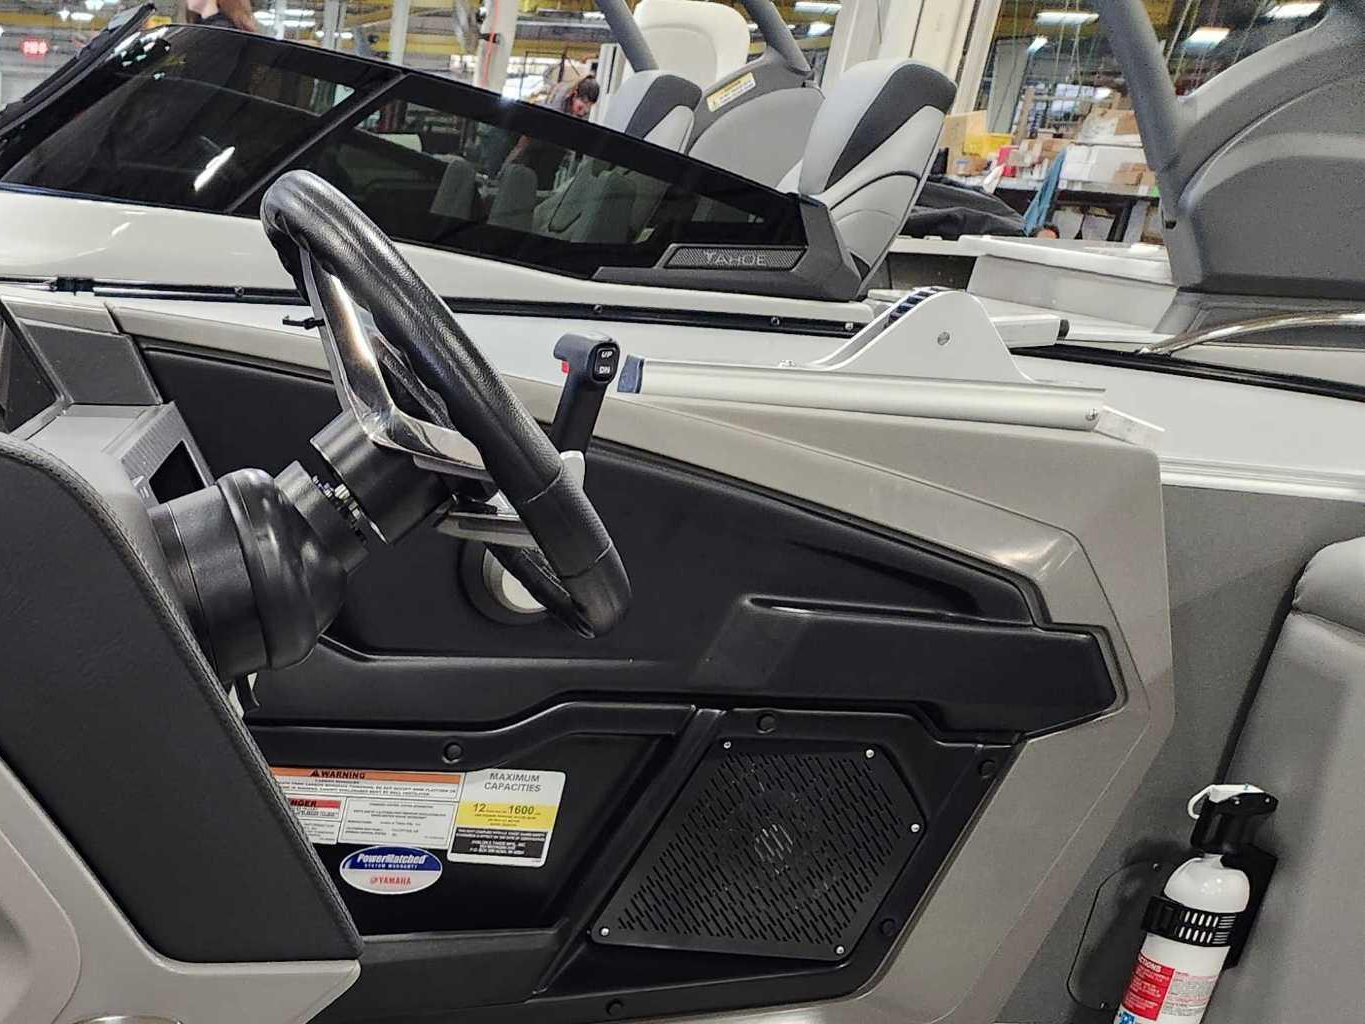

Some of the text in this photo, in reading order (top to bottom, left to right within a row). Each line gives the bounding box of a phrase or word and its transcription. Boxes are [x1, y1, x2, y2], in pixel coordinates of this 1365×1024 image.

[703, 250, 767, 266] TAHOE
[599, 366, 611, 374] DN
[321, 770, 365, 780] WARNING
[489, 772, 540, 783] MAXIMUM
[484, 782, 541, 793] CAPACITIES
[288, 799, 317, 808] NGER
[473, 803, 535, 815] 12 1600
[356, 853, 428, 864] PowerMatched
[379, 876, 412, 886] YAMAHA
